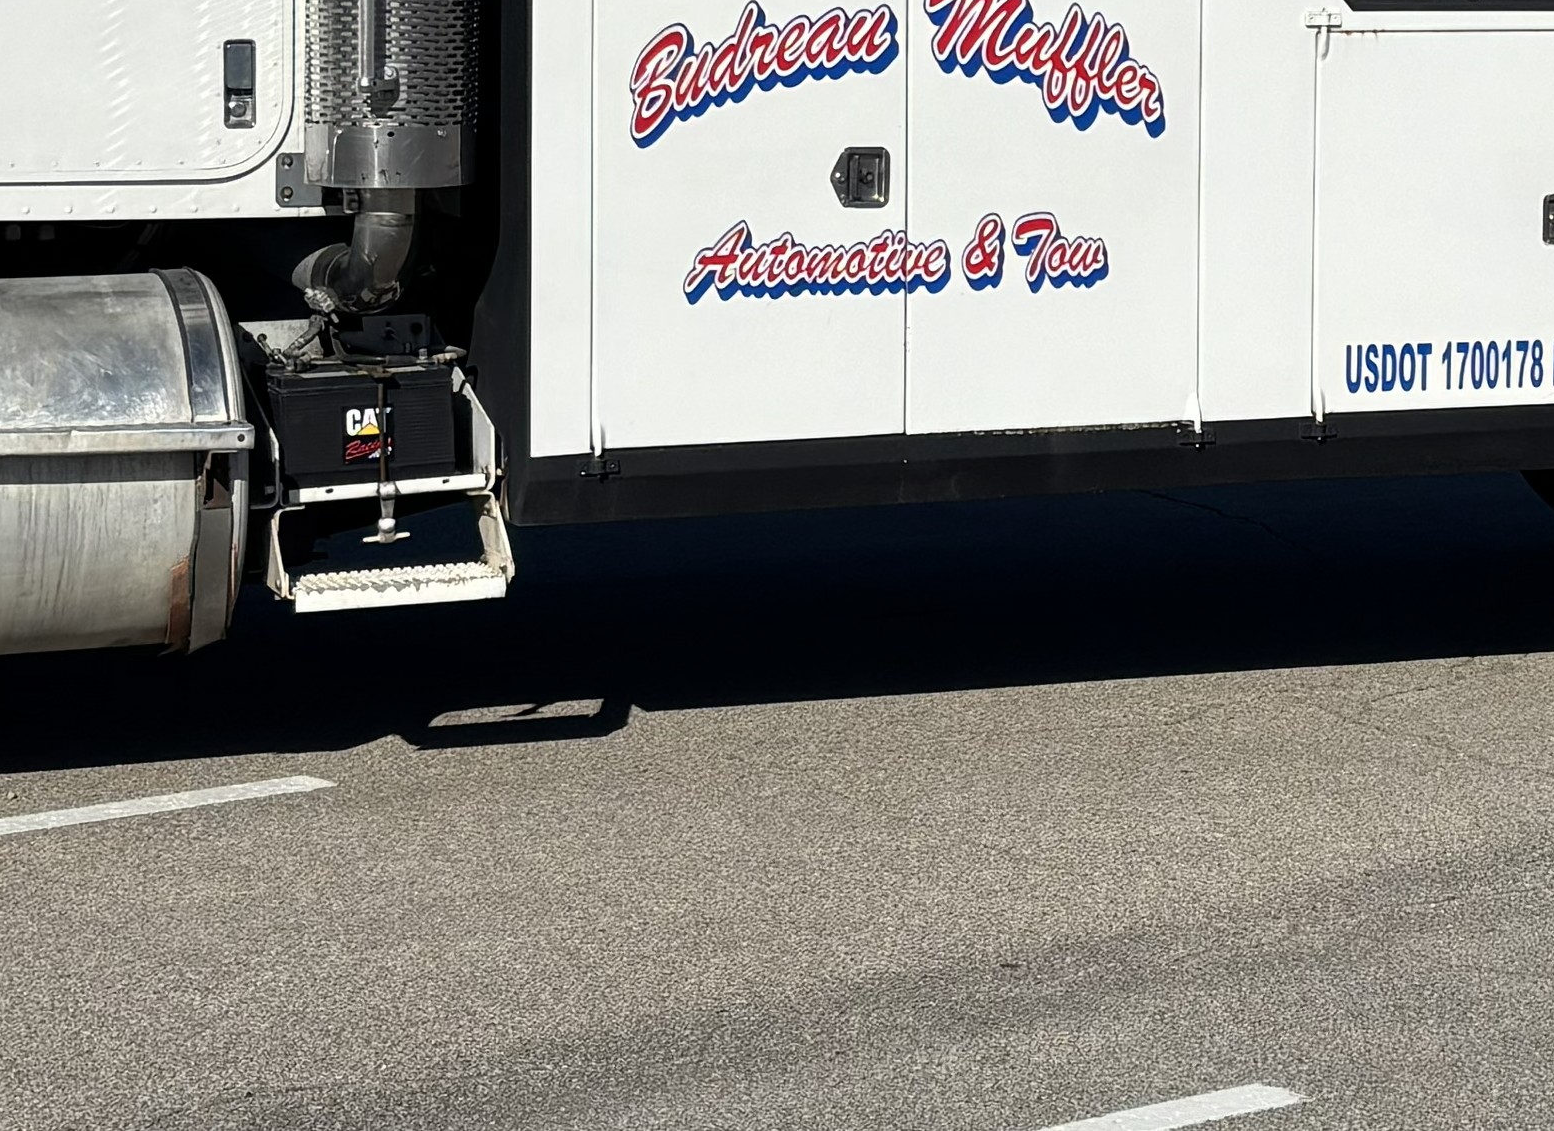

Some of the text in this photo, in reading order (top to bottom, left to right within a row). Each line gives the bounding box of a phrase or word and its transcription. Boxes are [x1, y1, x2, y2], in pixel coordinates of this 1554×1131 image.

[630, 0, 900, 149] Budreau
[683, 211, 1109, 305] Automotive & Tow
[1345, 343, 1432, 395] USDOT
[1440, 339, 1545, 391] 1700178
